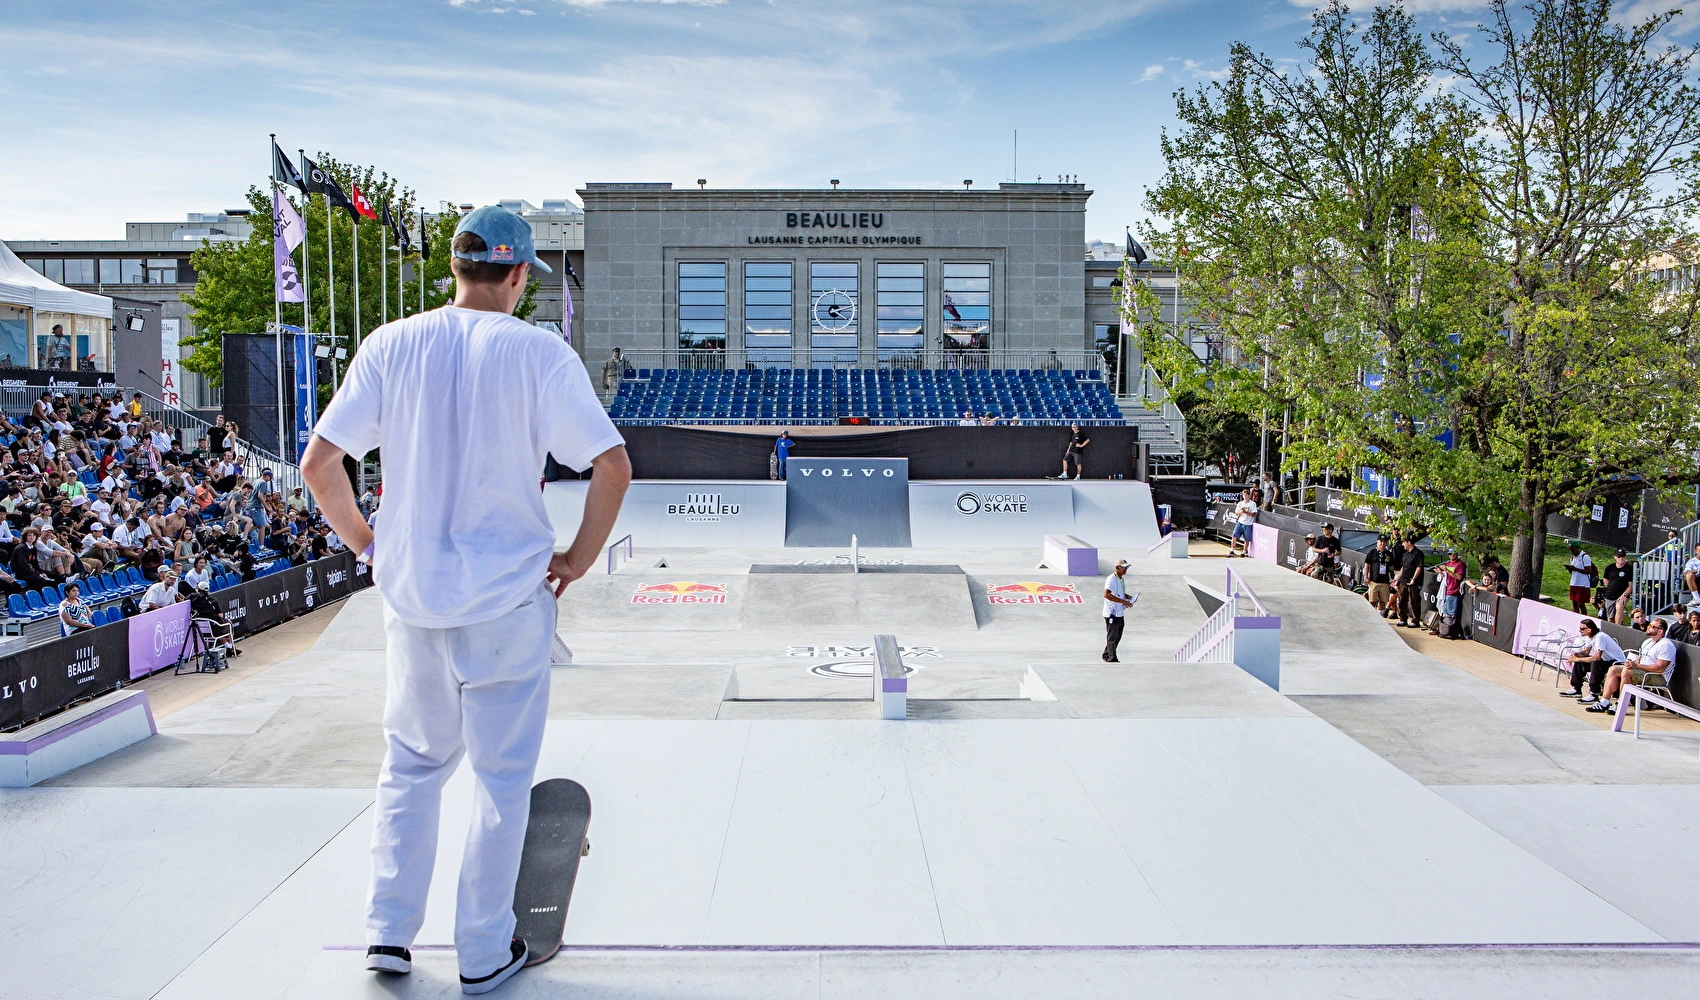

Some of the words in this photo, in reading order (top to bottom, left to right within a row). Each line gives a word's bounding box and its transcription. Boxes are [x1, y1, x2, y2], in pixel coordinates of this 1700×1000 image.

[786, 212, 883, 228] BEAULIEU
[748, 236, 803, 244] LAUSANNE
[808, 236, 858, 244] CAPITALE
[862, 236, 921, 245] OLYMPIQUE
[799, 468, 894, 477] VOLVO
[668, 495, 740, 514] BEAULIEU
[984, 494, 1027, 503] WORLD
[984, 503, 1028, 512] SKATE
[258, 591, 290, 608] VOLVO
[632, 594, 678, 603] Red
[681, 594, 726, 603] Bull
[988, 594, 1035, 603] Red
[1037, 594, 1083, 603] Bull
[165, 617, 185, 635] WORLD
[165, 630, 185, 650] SKATE
[67, 645, 100, 677] BEAULIEU
